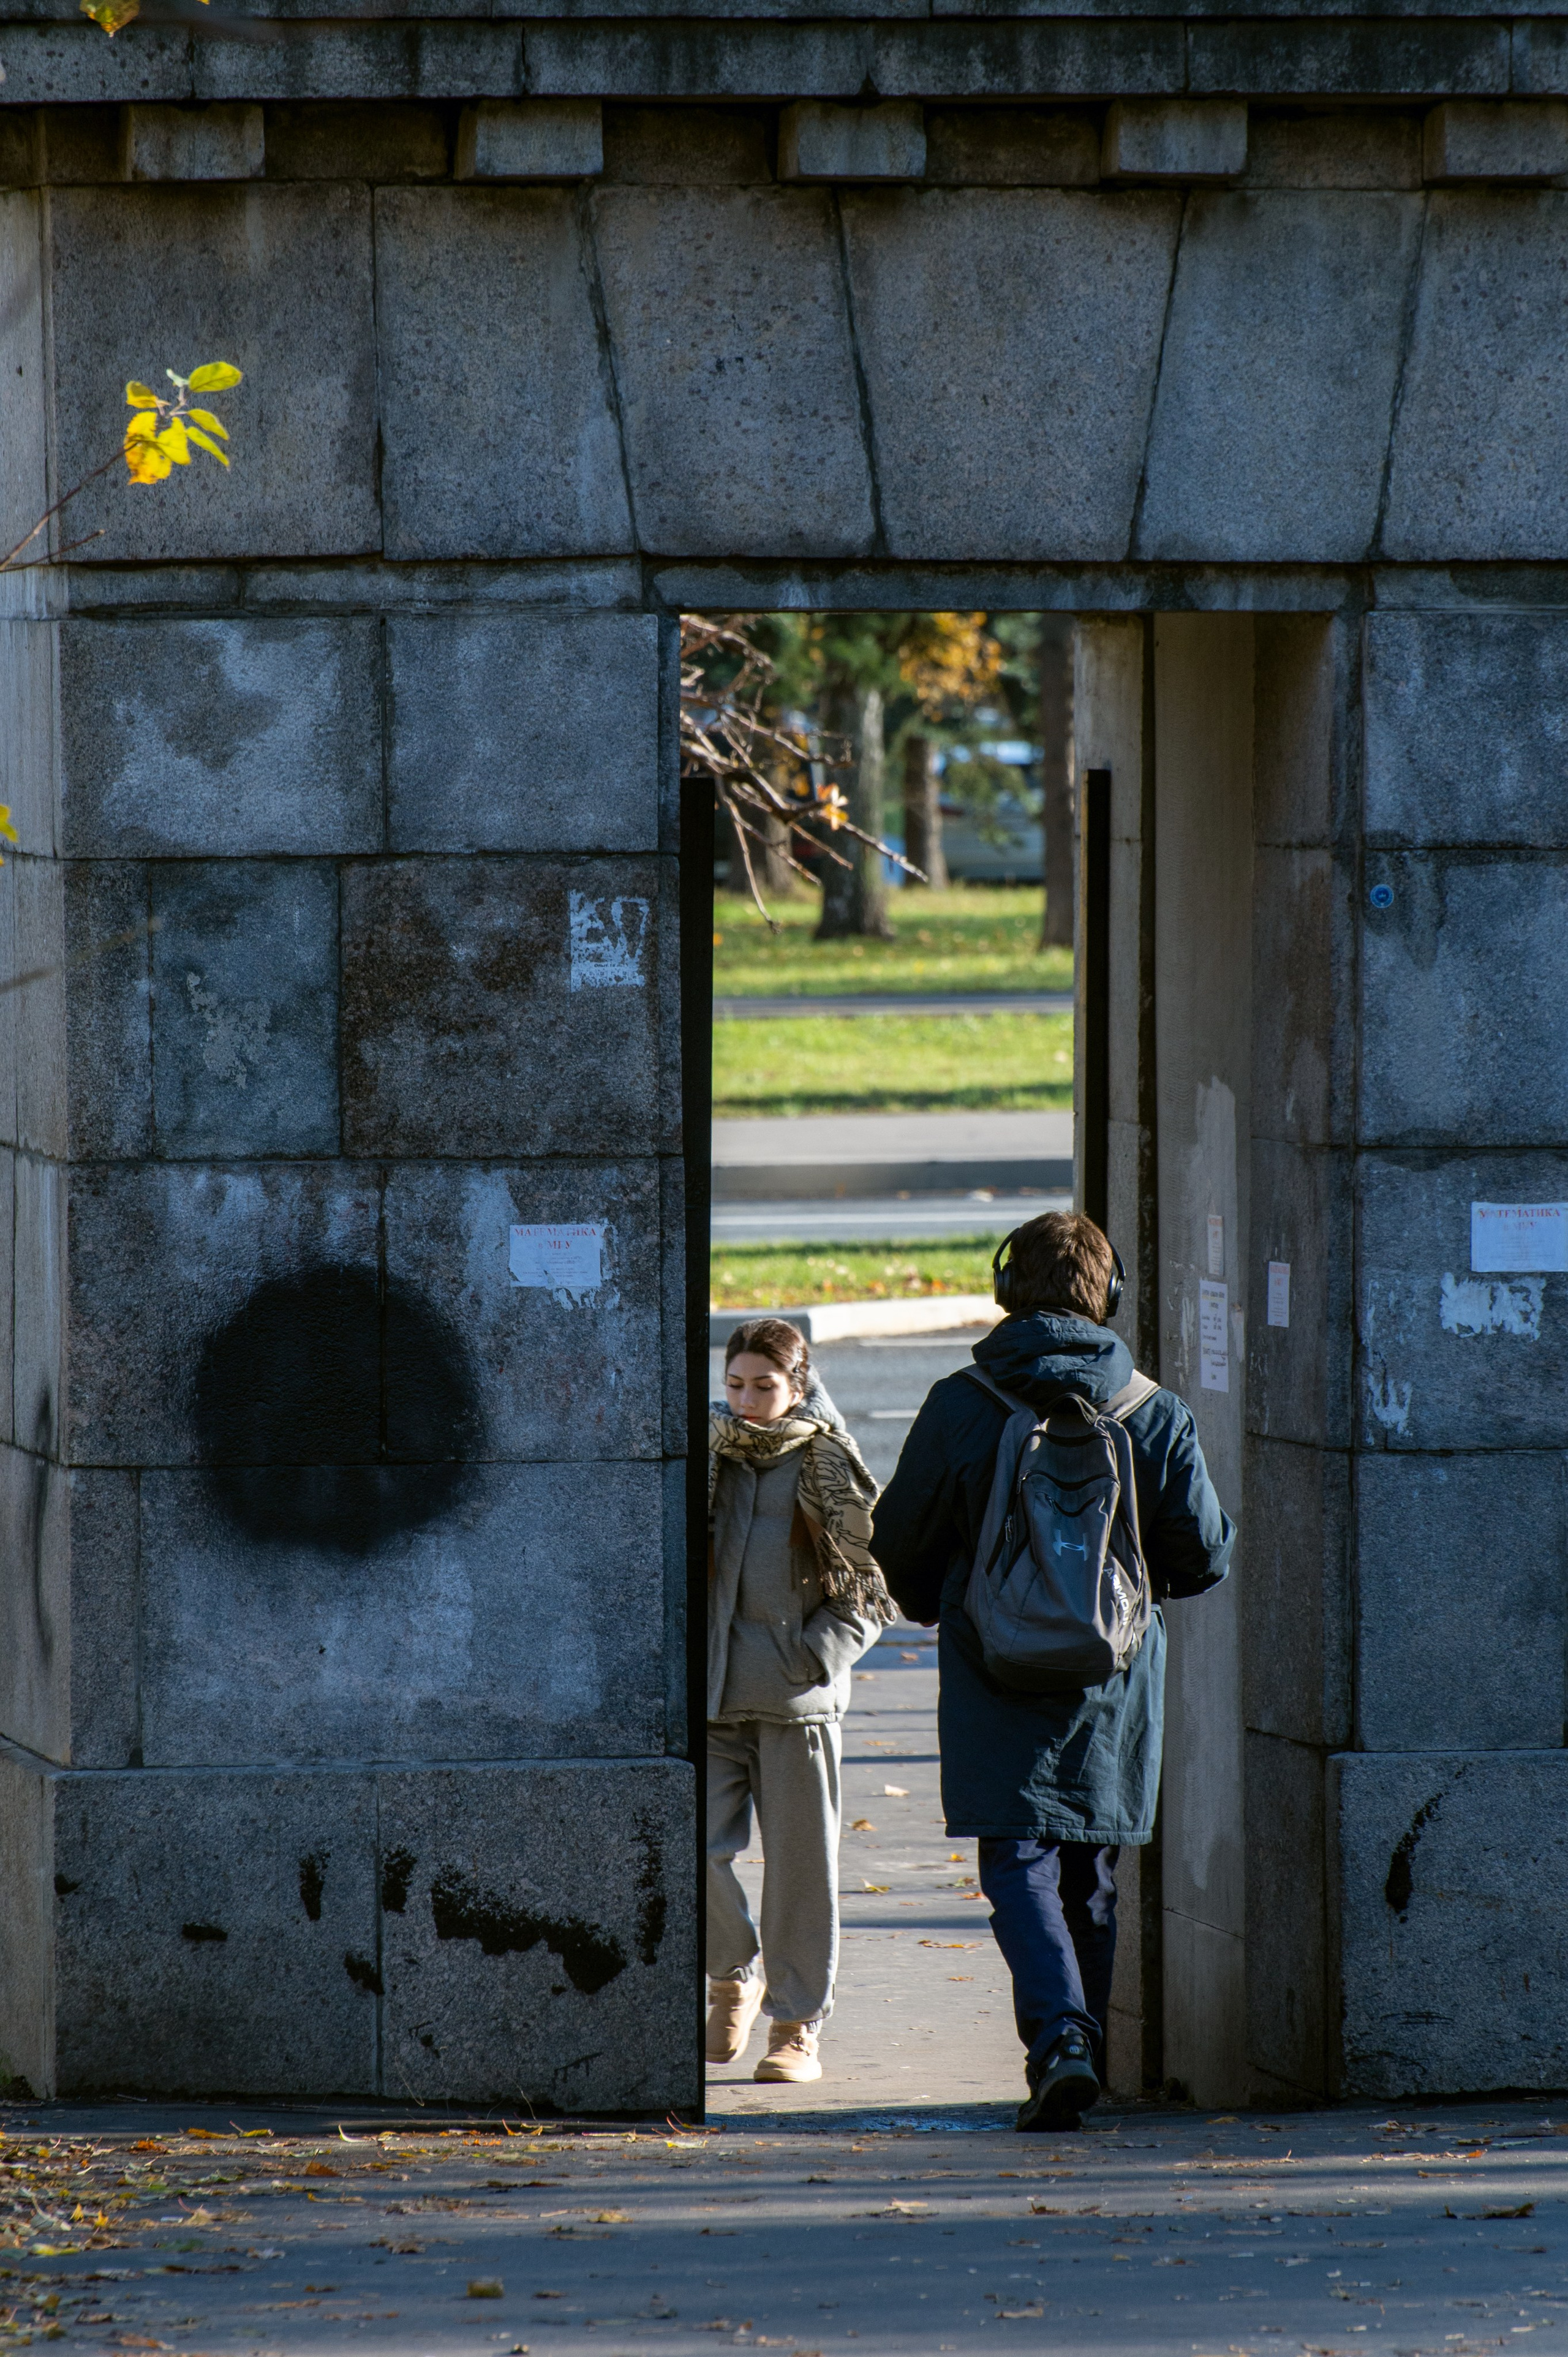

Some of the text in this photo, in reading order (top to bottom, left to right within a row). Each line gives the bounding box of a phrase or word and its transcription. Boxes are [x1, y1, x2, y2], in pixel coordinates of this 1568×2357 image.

[1479, 1208, 1561, 1218] МТЕМАТИКА
[514, 1228, 597, 1237] МАТЕМАТИКА
[548, 1240, 573, 1250] МГУ
[1104, 1568, 1129, 1626] ARMOU
